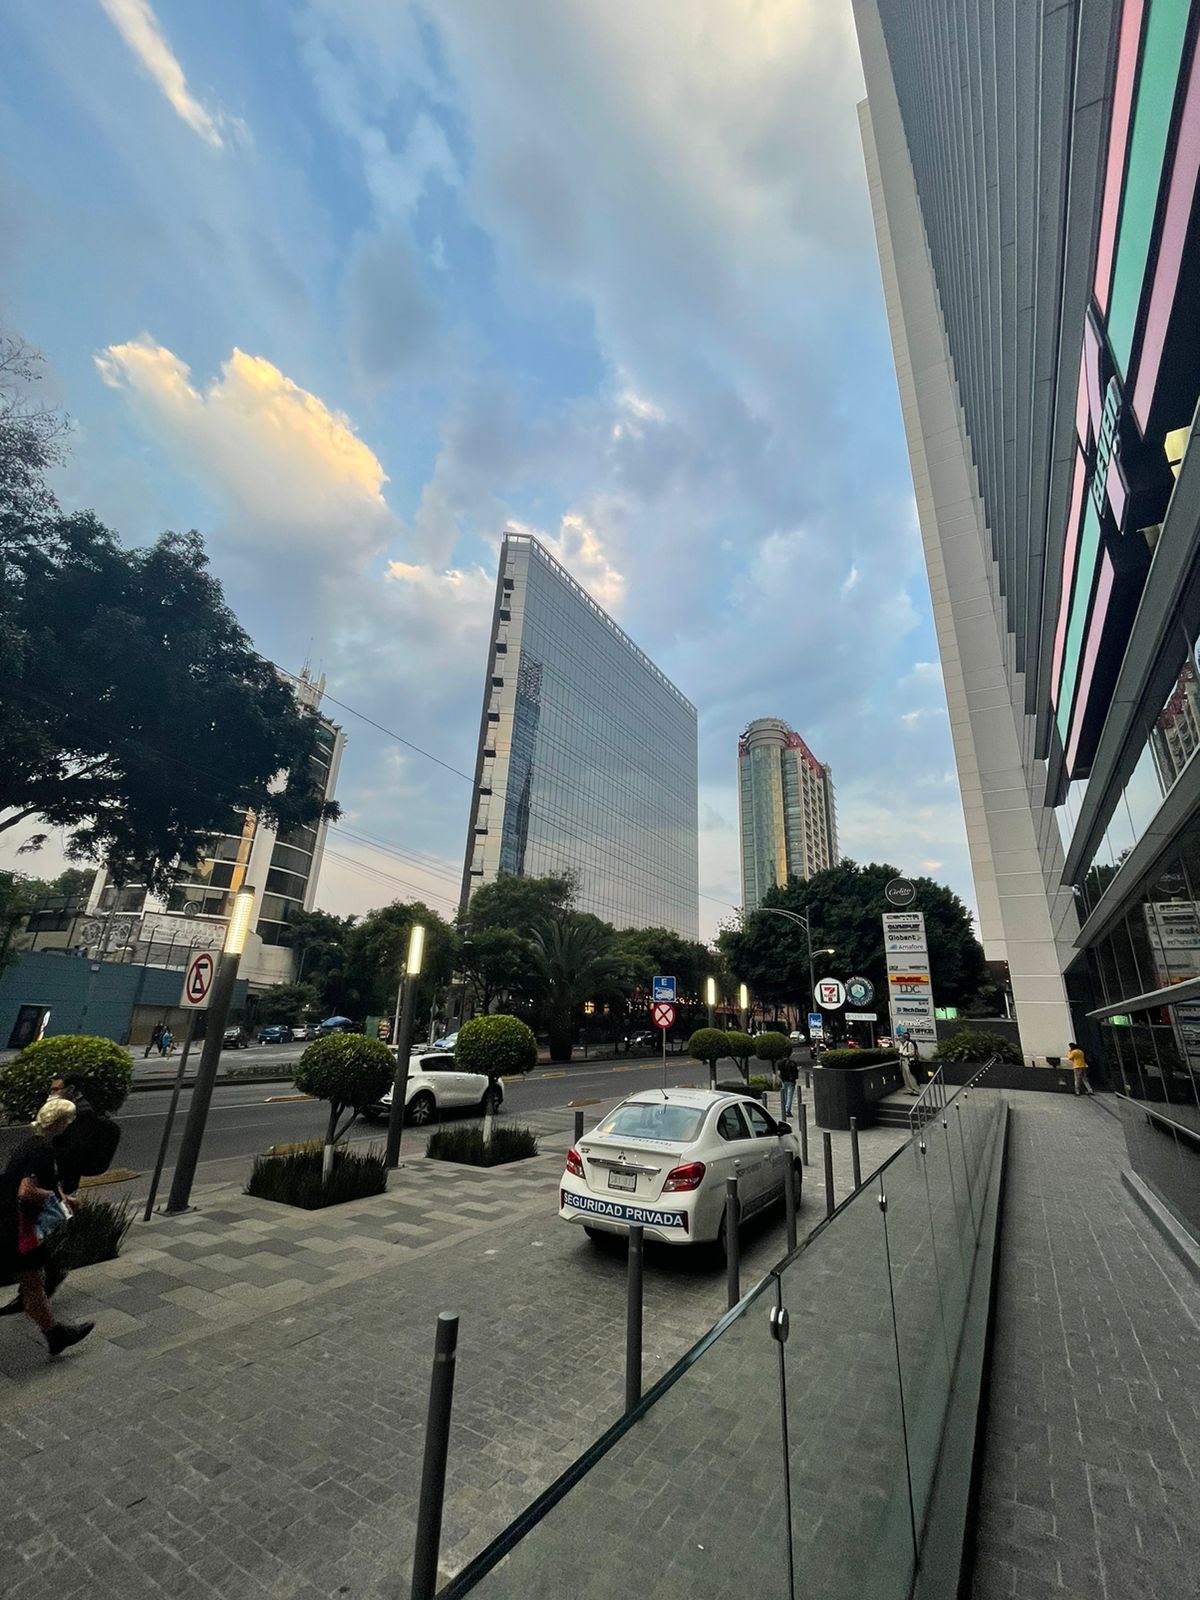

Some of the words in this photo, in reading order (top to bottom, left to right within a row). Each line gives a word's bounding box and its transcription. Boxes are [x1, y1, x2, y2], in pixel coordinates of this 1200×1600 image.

[661, 978, 668, 986] E
[564, 1192, 623, 1217] SEGURIDAD
[625, 1207, 684, 1226] PRIVADA
